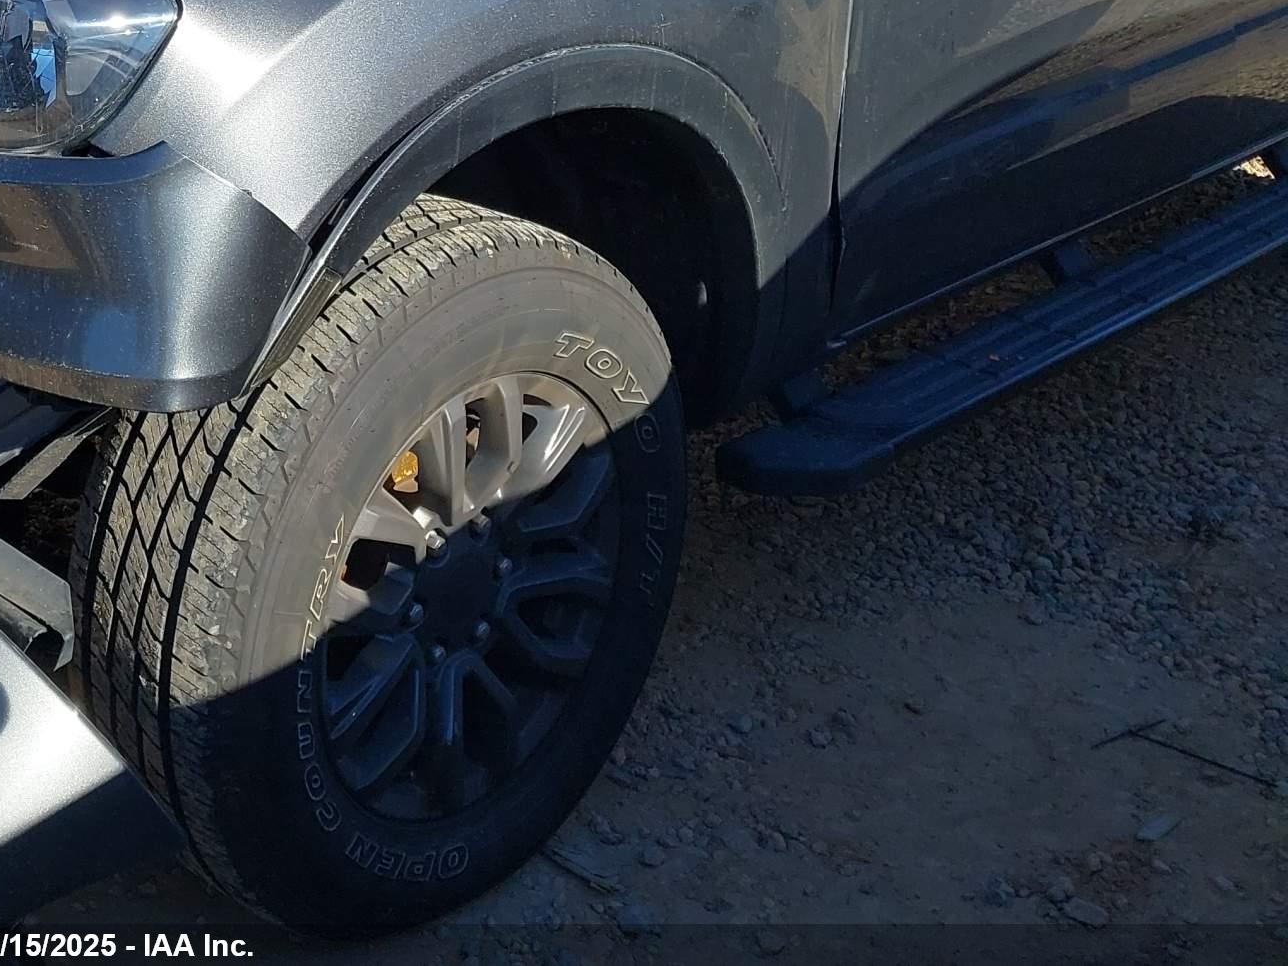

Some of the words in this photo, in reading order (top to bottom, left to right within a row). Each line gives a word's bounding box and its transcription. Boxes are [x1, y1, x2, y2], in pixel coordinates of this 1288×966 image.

[554, 331, 662, 454] TOYO
[296, 512, 346, 832] COUNTRY
[344, 833, 470, 882] OPEN
